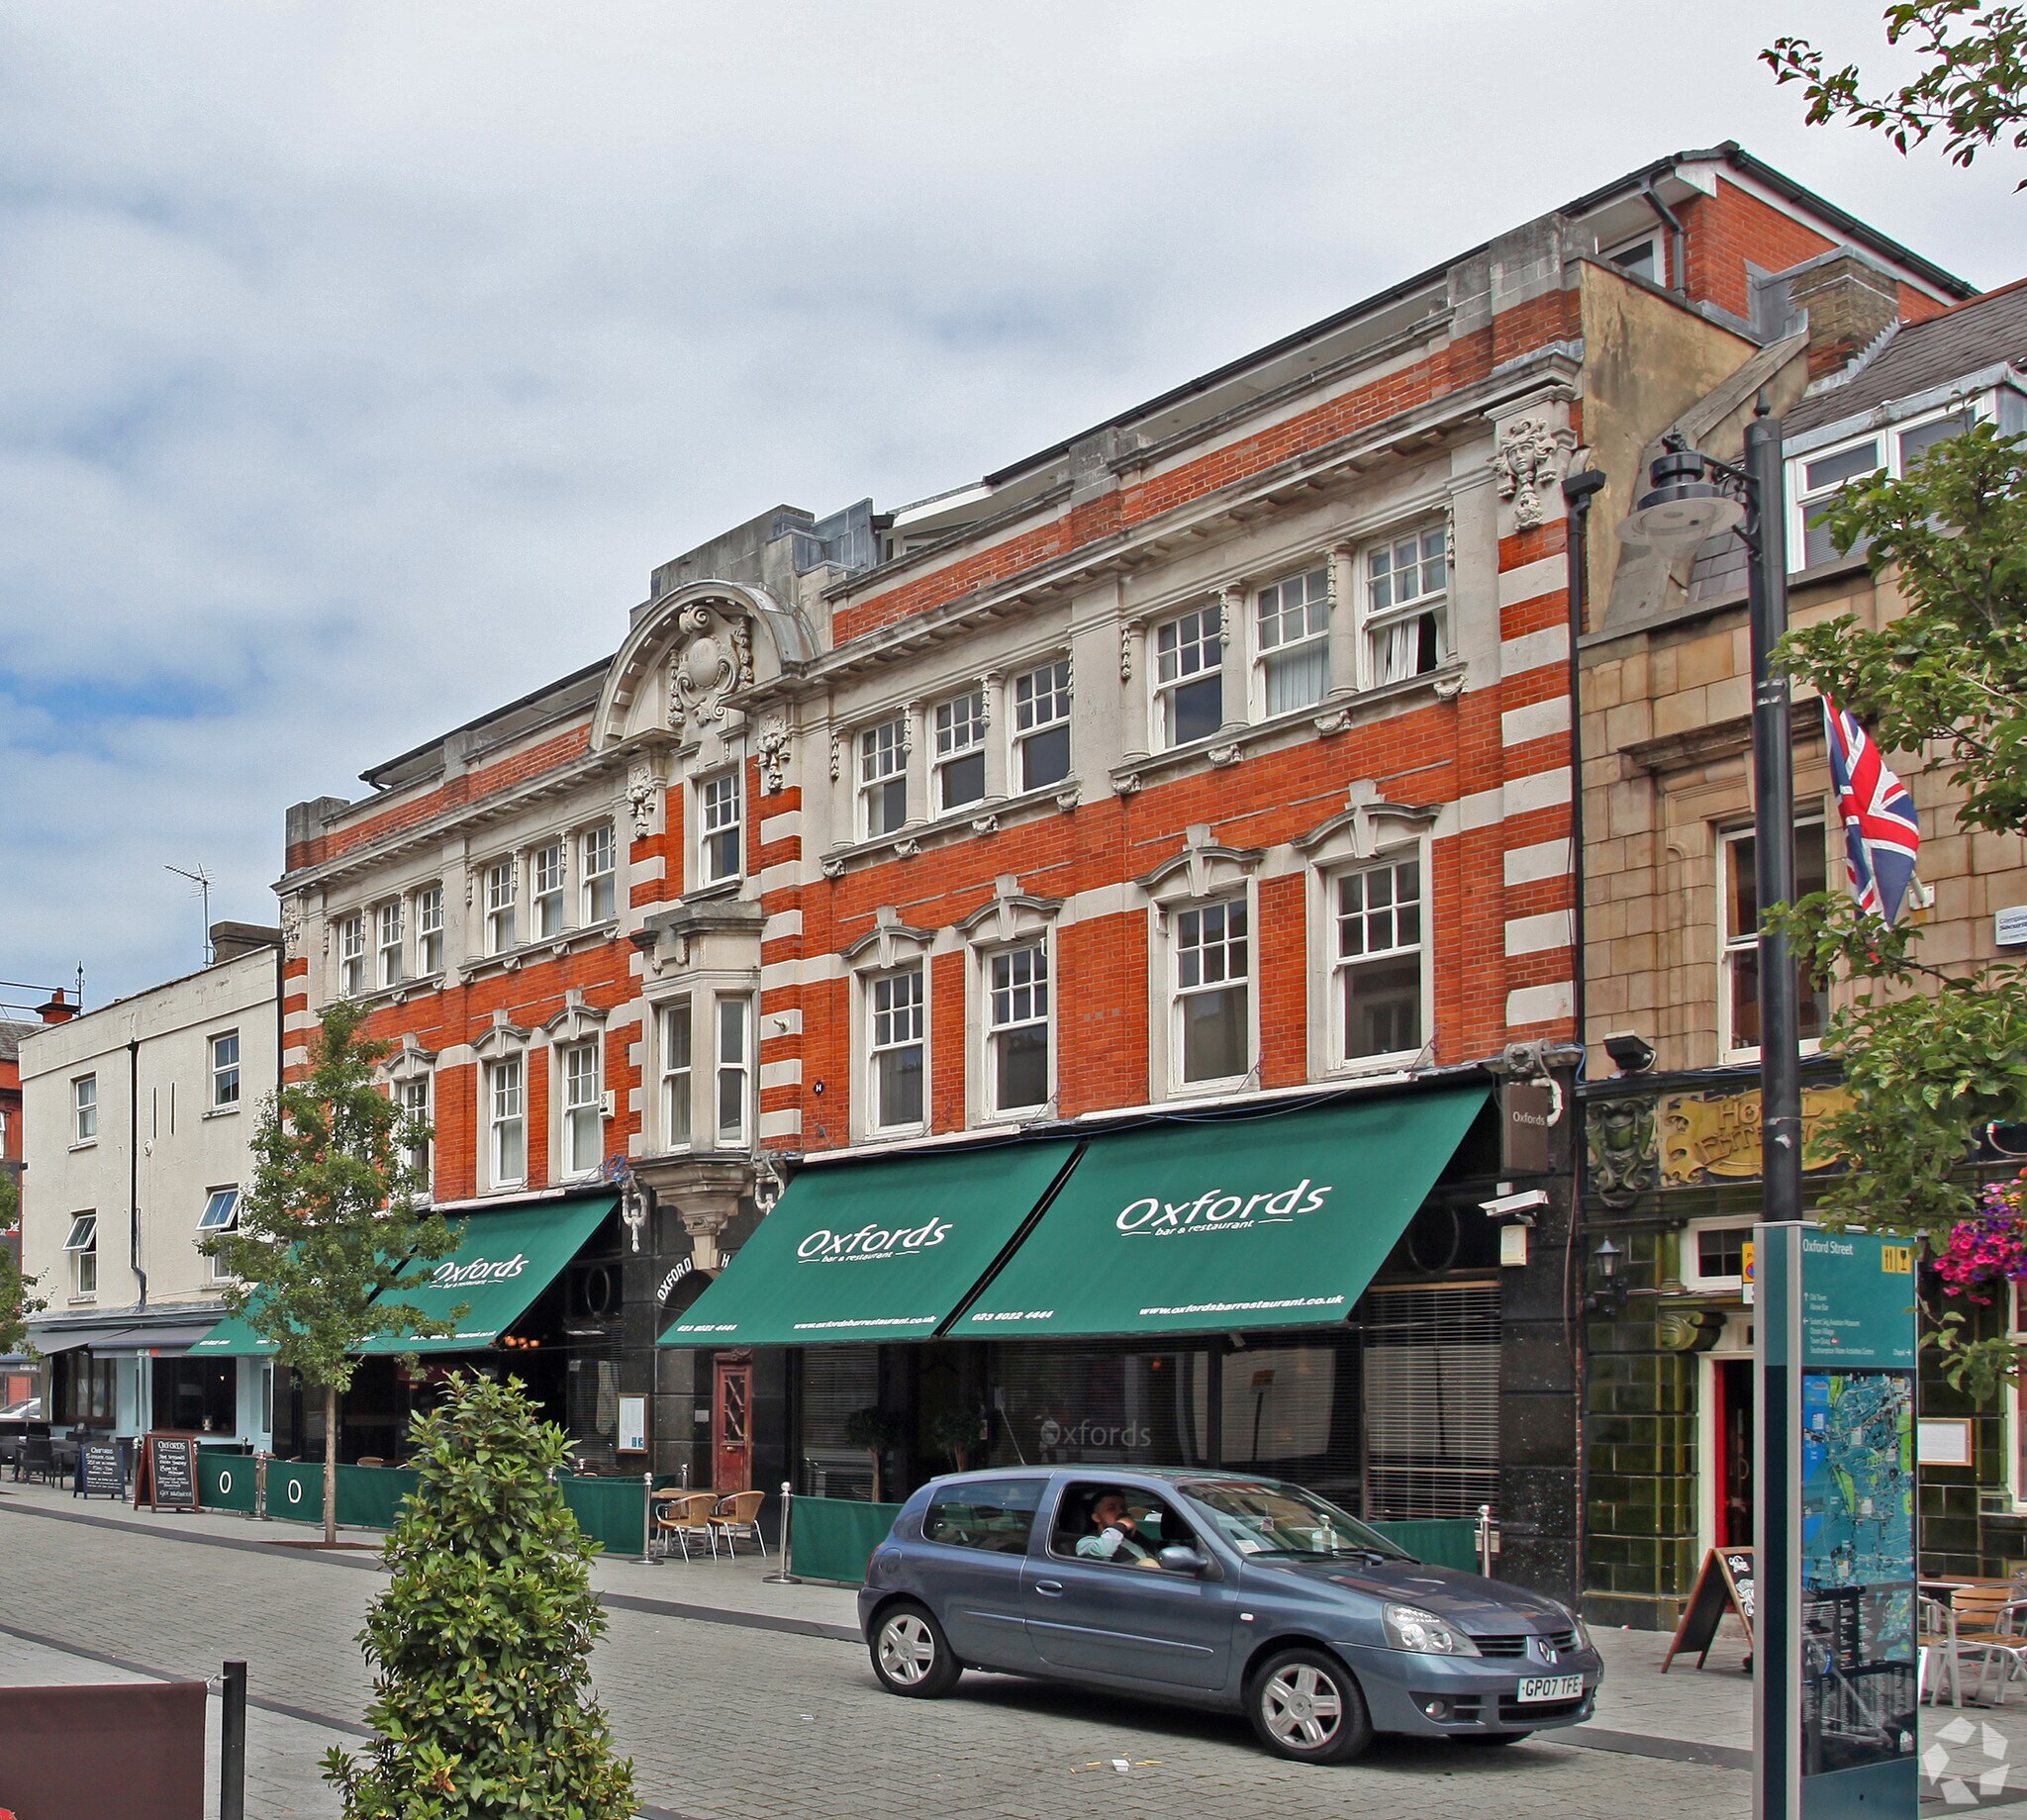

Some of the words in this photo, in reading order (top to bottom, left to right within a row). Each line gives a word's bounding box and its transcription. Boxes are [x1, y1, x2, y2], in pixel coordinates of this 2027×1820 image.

[1512, 1110, 1545, 1126] Oxfords
[1115, 1179, 1332, 1230] Oxfords
[797, 1216, 953, 1257] Oxfords
[1155, 1225, 1177, 1236] bar
[1188, 1220, 1255, 1233] restaurant
[821, 1254, 836, 1263] bar
[845, 1251, 893, 1262] restaurant
[1802, 1238, 1829, 1253] Oxford
[1830, 1241, 1854, 1256] Street
[656, 1257, 693, 1301] OXFORD
[1139, 1294, 1345, 1316] www.oxfordsbarrestaurant.co.uk
[1040, 1418, 1151, 1447] Oxfords
[1524, 1677, 1558, 1697] GP07
[1561, 1676, 1580, 1694] TFE
